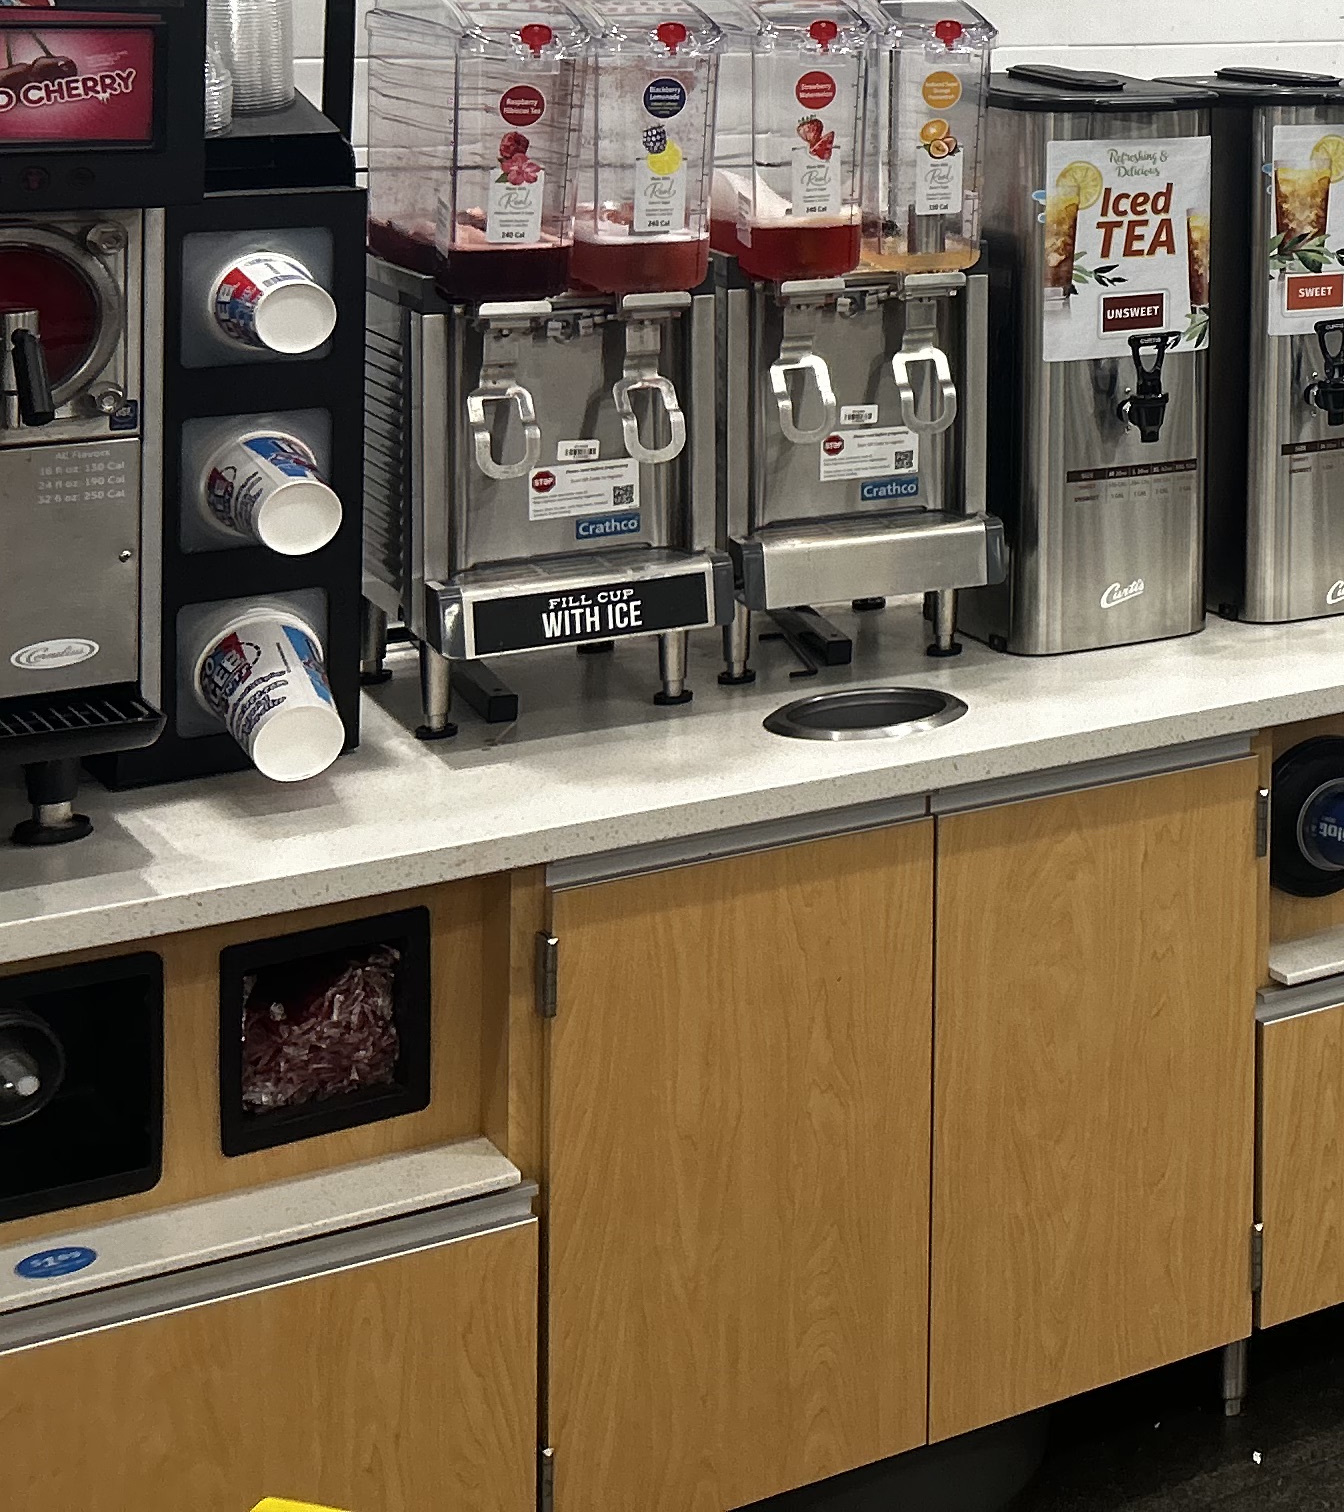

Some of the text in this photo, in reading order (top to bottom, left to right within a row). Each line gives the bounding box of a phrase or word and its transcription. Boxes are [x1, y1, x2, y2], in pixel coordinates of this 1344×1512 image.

[20, 69, 137, 107] CHERRY
[650, 86, 681, 94] Blackberry
[1106, 148, 1158, 164] Refreshing
[1116, 166, 1160, 178] Delicious
[1100, 182, 1174, 217] Iced
[1095, 218, 1176, 259] TEA
[1298, 286, 1333, 298] SWEET
[1106, 306, 1160, 320] UNSWEET
[107, 461, 125, 470] Cal
[107, 475, 125, 484] Cal
[107, 489, 125, 498] Cal
[863, 482, 917, 498] Crathco
[579, 519, 638, 535] Crathco
[548, 589, 634, 610] FILL CUP
[1100, 578, 1145, 609] Curtis
[541, 600, 643, 639] WITH ICE
